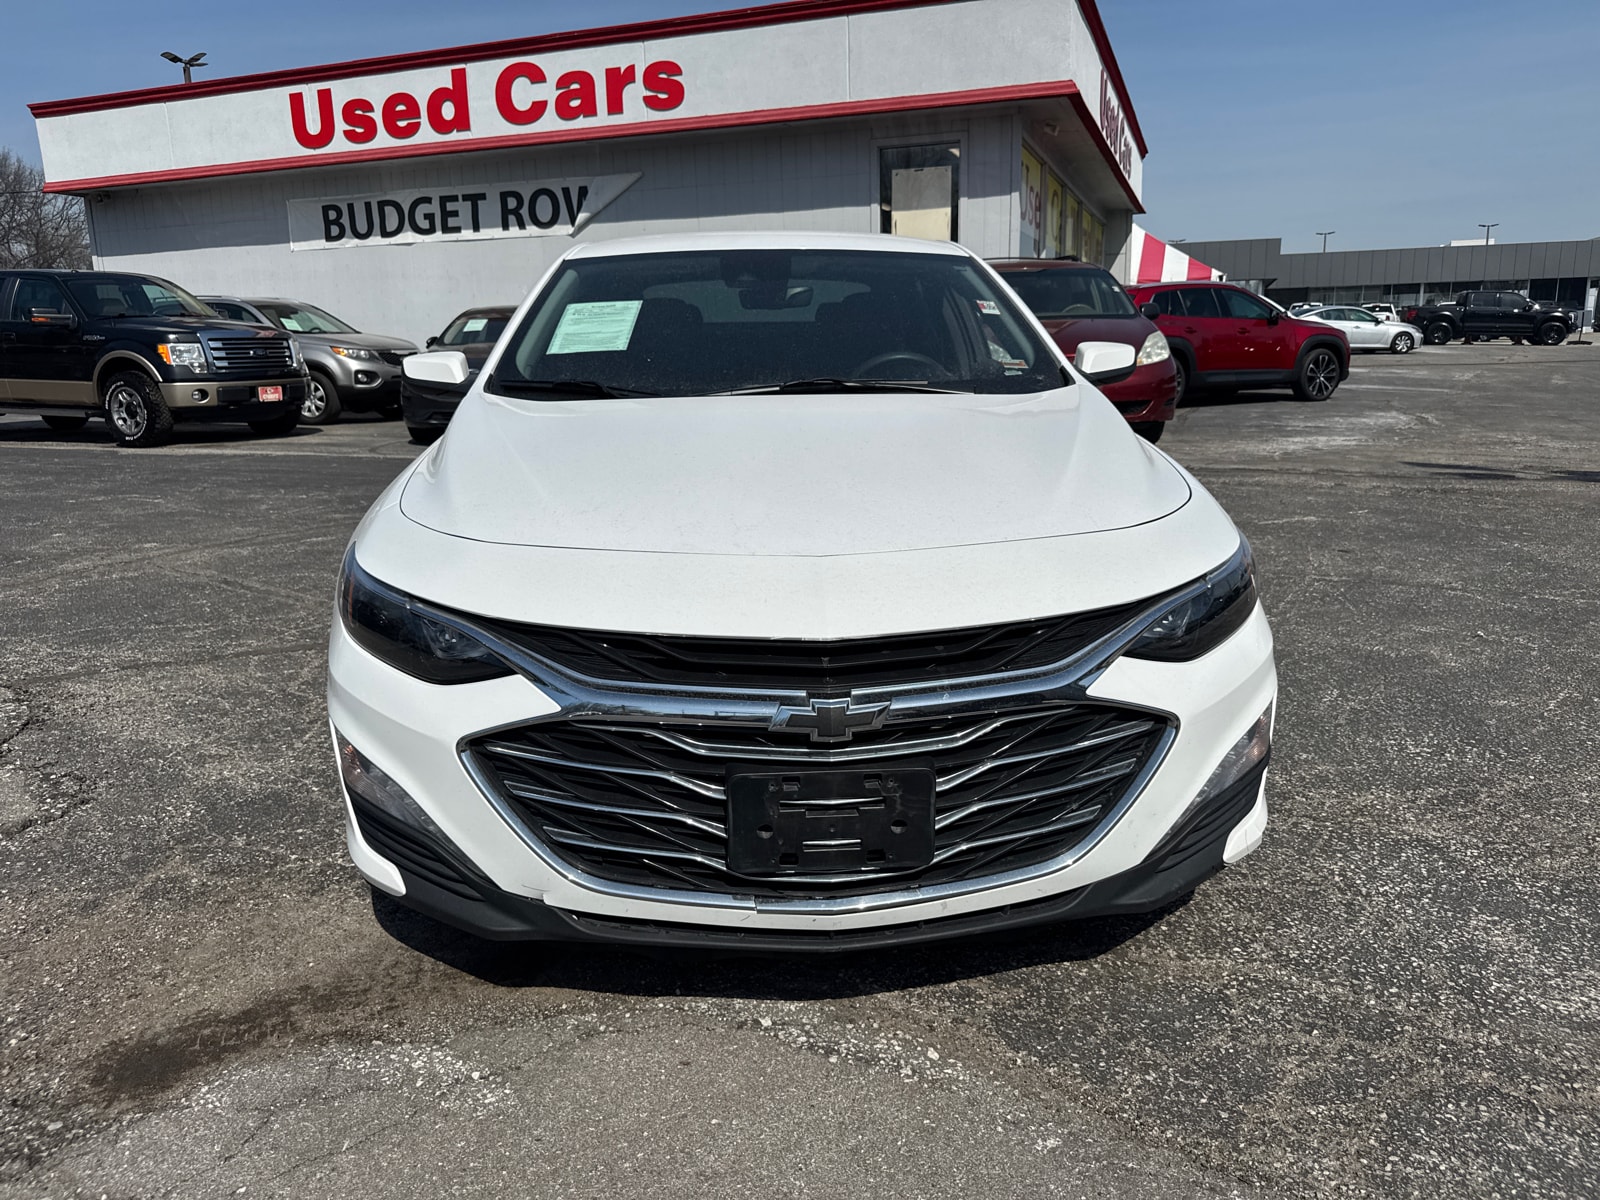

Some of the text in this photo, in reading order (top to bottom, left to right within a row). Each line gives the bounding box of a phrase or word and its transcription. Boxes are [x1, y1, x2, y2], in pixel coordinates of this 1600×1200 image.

[289, 60, 684, 149] Used Cars
[1100, 68, 1132, 181] Used Cars
[321, 193, 486, 243] BUDGET
